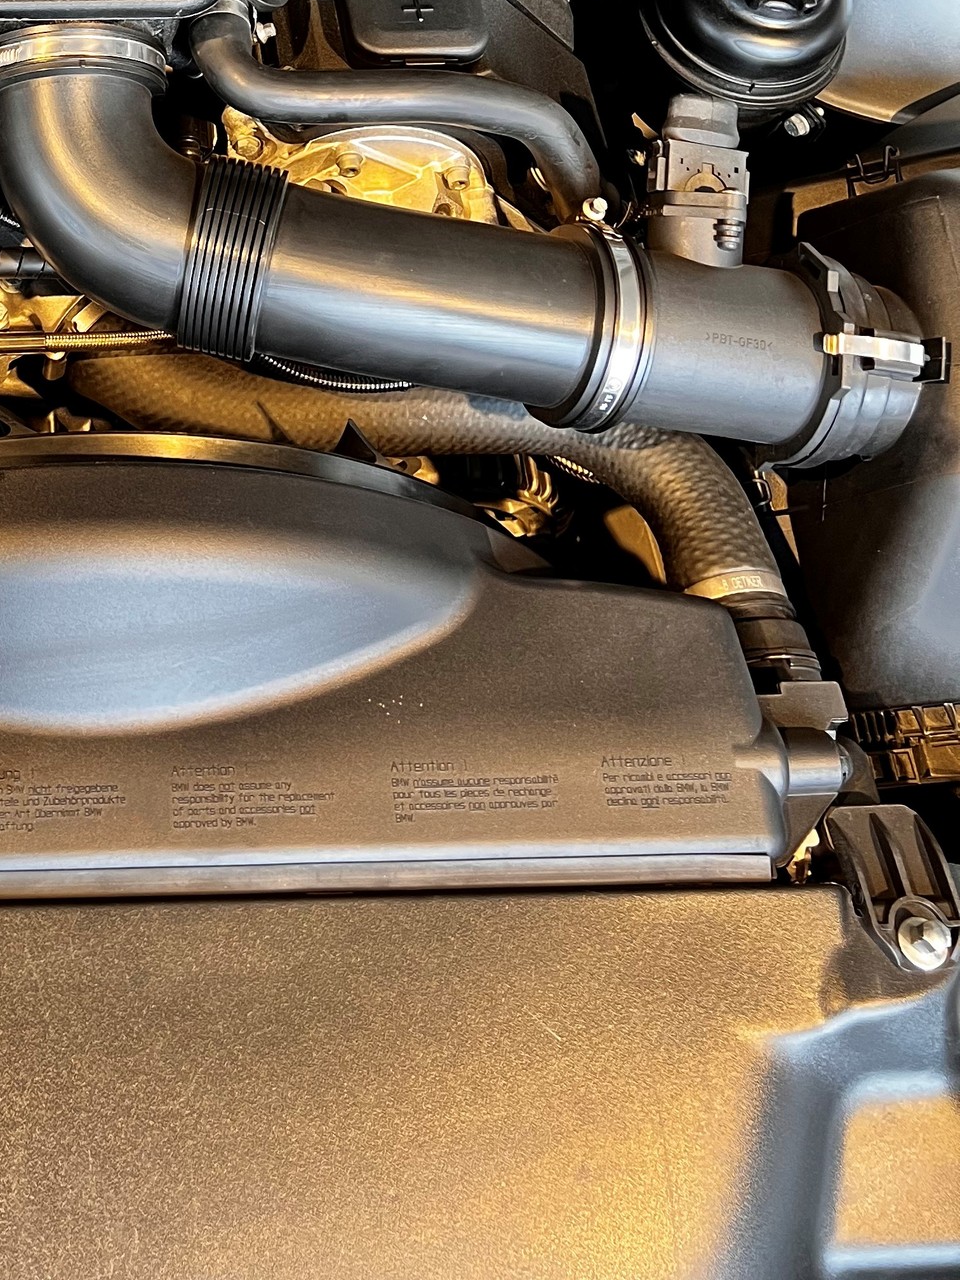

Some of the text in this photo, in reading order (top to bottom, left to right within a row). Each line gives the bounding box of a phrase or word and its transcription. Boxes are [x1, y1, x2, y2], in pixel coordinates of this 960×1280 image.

[390, 759, 454, 773] Attention
[601, 755, 672, 768] Attenzione
[171, 764, 236, 778] Attention
[602, 772, 620, 782] Per
[657, 773, 664, 781] e
[665, 770, 711, 781] accessori
[714, 772, 732, 782] non
[171, 781, 292, 793] BMW does not assume any
[391, 777, 409, 788] BMW
[457, 776, 490, 788] aucune
[604, 783, 651, 795] approvati
[710, 781, 730, 792] BMW
[6, 784, 24, 795] BMW
[28, 784, 52, 796] nicht
[56, 783, 119, 795] freigegebene
[393, 790, 414, 800] pour
[419, 789, 440, 799] tous
[444, 788, 457, 798] les
[493, 788, 505, 797] de
[23, 796, 40, 806] und
[172, 791, 335, 805] responsibility for the replacement
[641, 795, 660, 809] ogni
[173, 804, 316, 817] of parts and accessories not
[394, 802, 405, 812] et
[409, 801, 466, 811] accessoires
[469, 801, 486, 811] non
[541, 799, 559, 808] par
[14, 809, 31, 818] Art
[84, 807, 102, 817] BMW
[173, 818, 218, 829] approved
[221, 818, 233, 829] by
